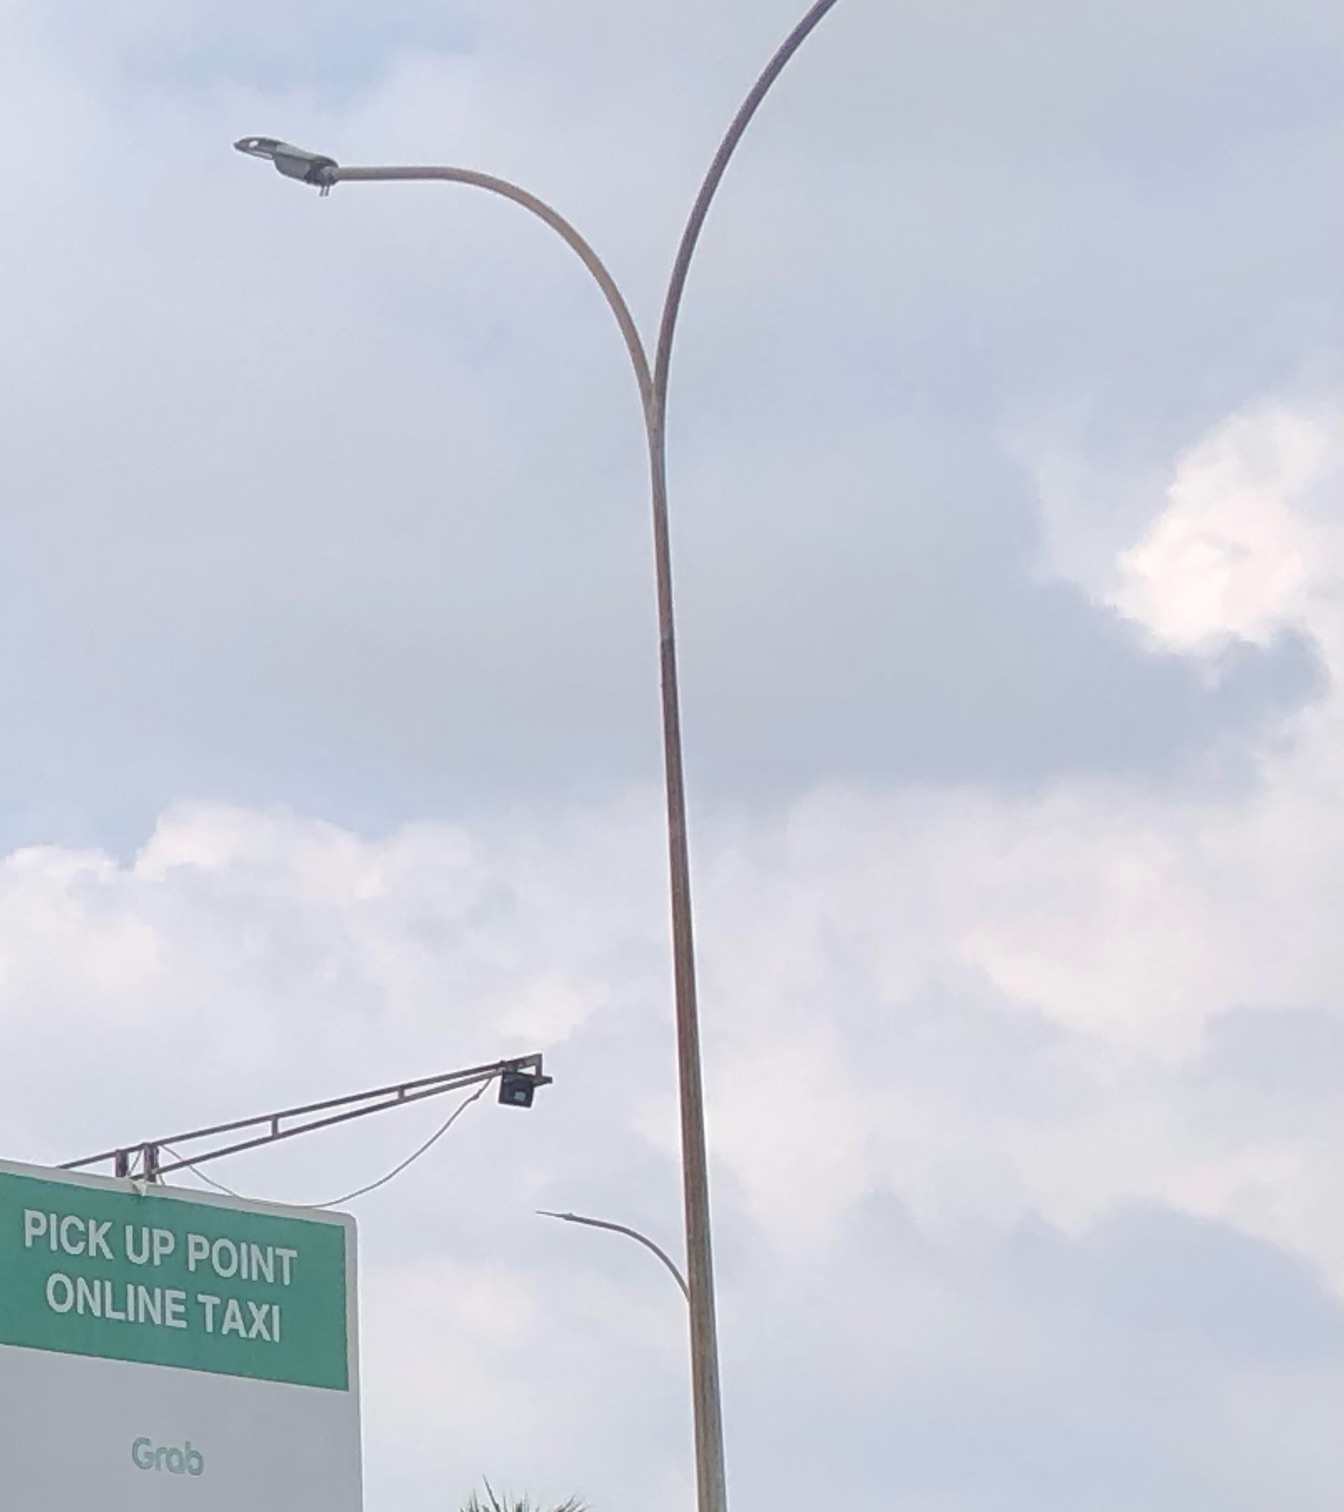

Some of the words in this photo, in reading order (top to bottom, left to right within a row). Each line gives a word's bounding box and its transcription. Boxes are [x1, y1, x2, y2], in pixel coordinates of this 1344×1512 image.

[24, 1208, 114, 1260] PICK
[125, 1224, 175, 1266] UP
[187, 1233, 298, 1286] POINT
[46, 1272, 188, 1329] ONLINE
[197, 1293, 280, 1343] TAXI
[131, 1436, 204, 1476] Grab
